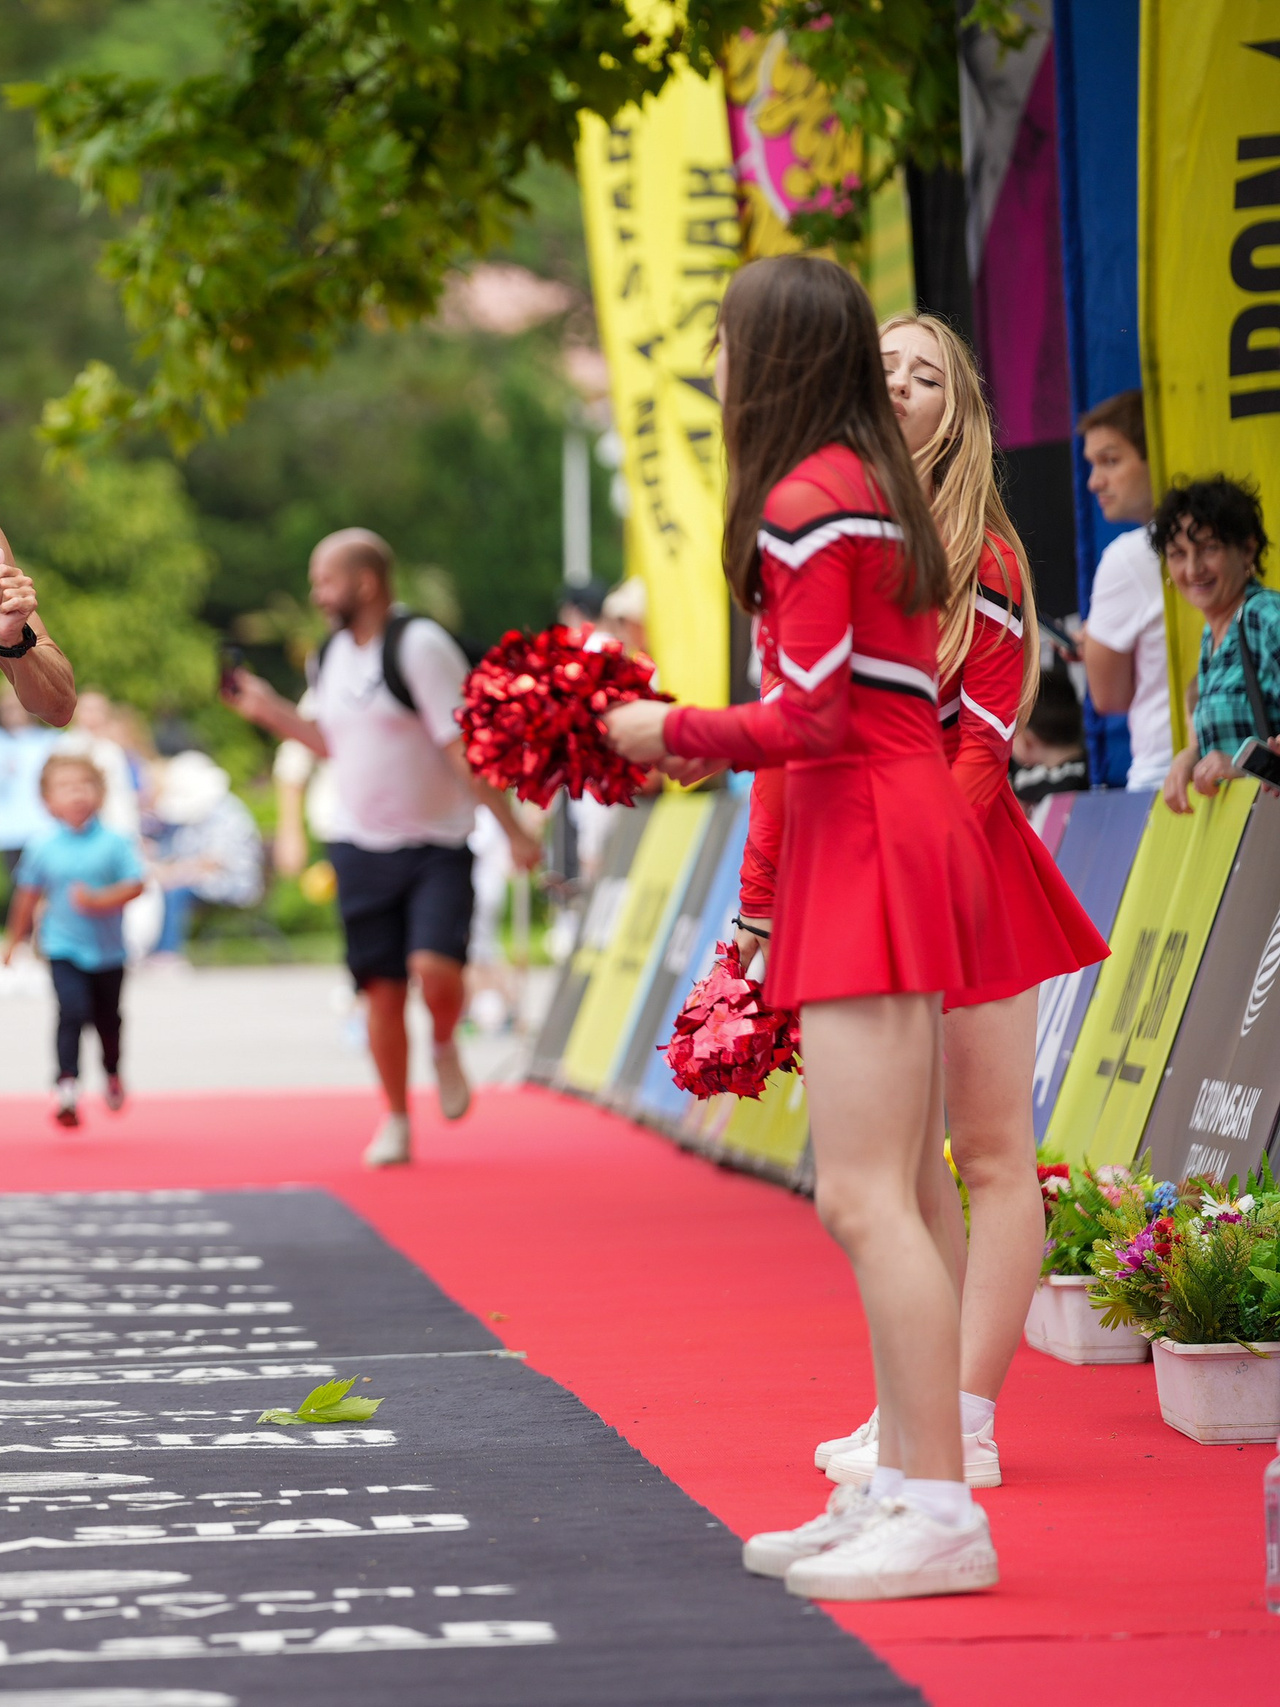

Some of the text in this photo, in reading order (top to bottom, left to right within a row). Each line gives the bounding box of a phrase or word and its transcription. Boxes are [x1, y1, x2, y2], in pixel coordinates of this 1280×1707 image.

[28, 1365, 336, 1382] STAR
[51, 1430, 397, 1447] STAR
[74, 1514, 468, 1540] STAR
